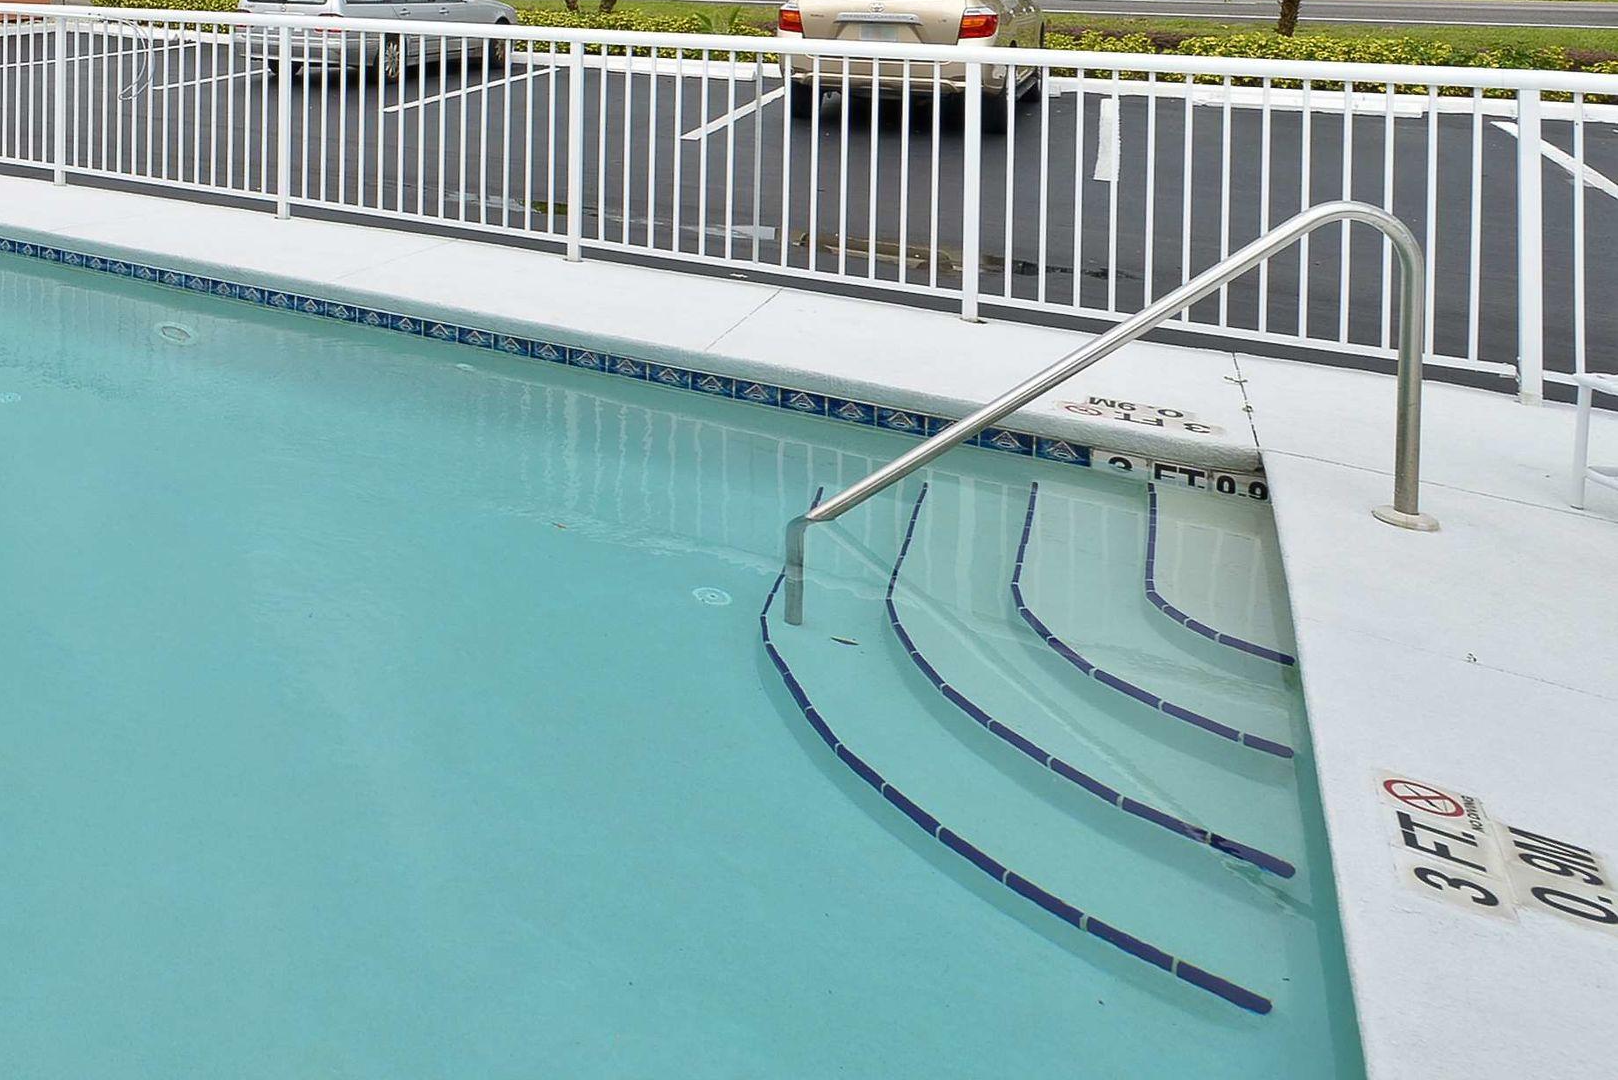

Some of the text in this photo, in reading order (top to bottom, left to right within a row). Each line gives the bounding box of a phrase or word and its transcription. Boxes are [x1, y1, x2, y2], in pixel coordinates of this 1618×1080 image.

[1183, 422, 1211, 434] 3
[1460, 794, 1485, 834] NO DIVING
[1413, 866, 1500, 908] 3
